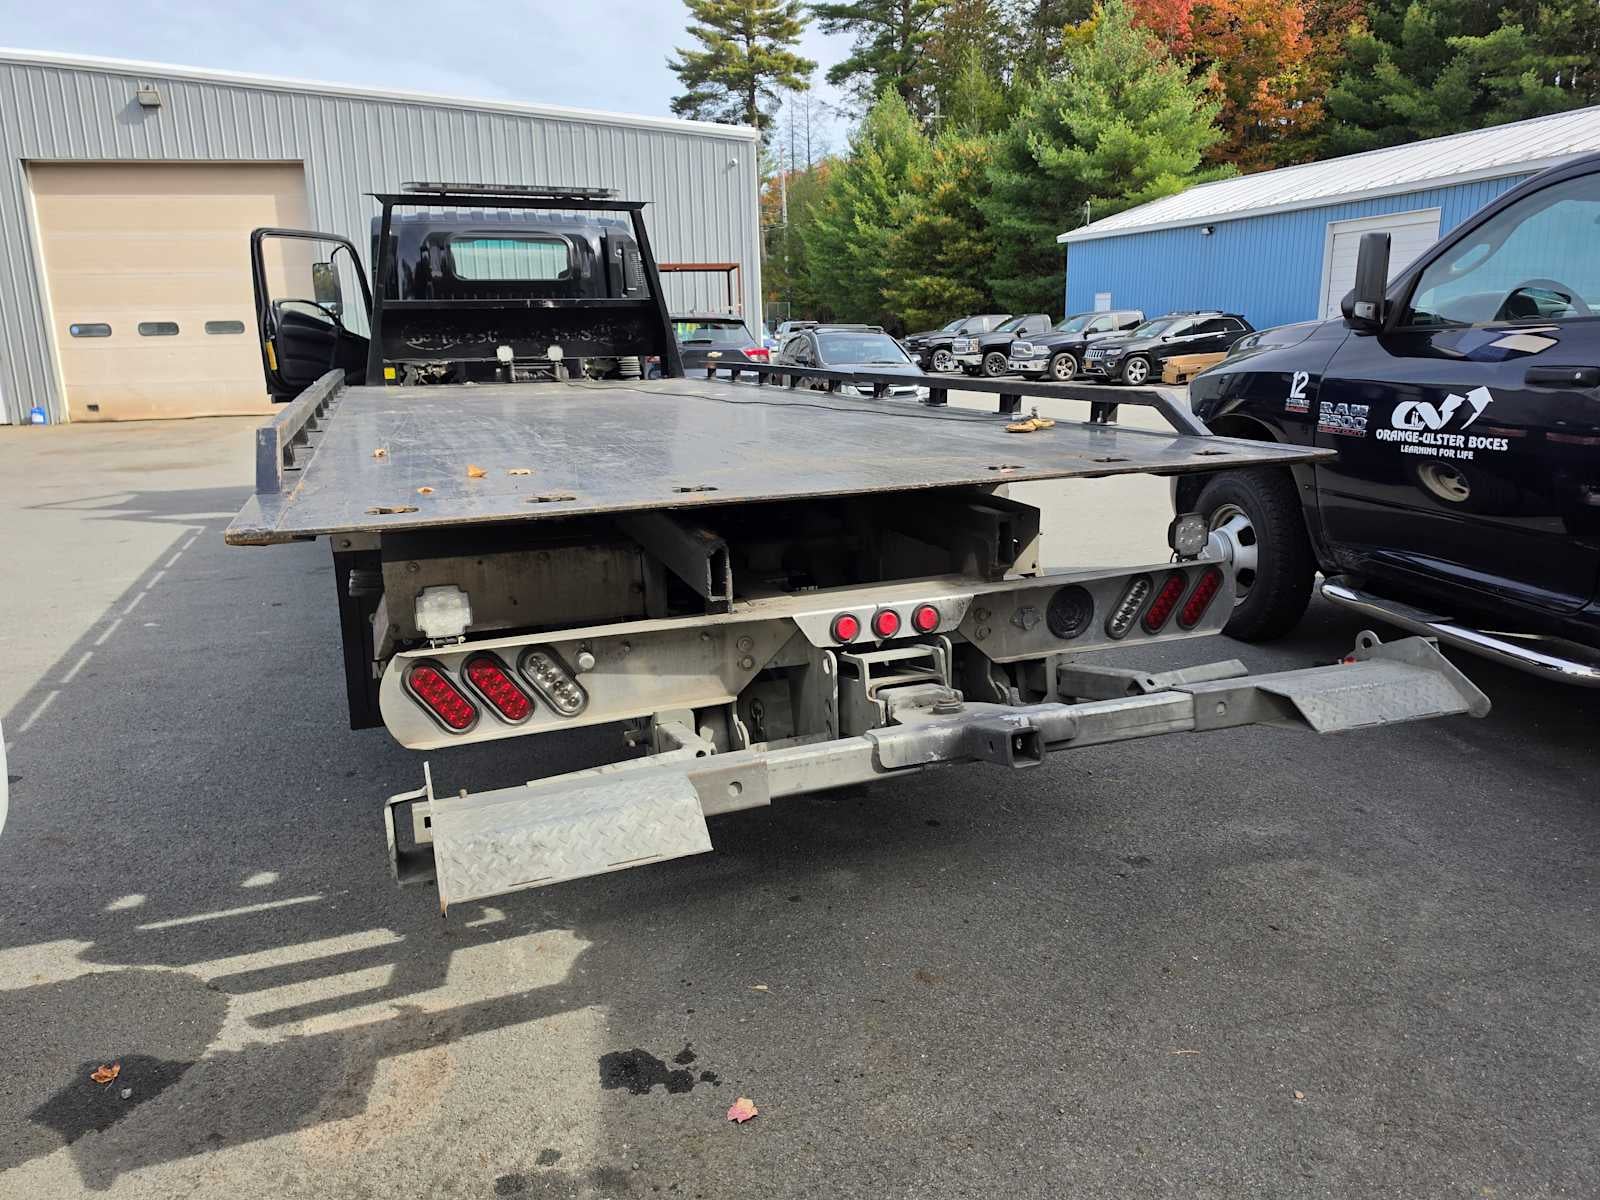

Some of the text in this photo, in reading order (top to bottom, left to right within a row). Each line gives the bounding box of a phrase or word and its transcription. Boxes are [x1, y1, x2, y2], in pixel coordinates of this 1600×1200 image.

[1290, 371, 1309, 399] 12
[1320, 401, 1369, 417] RAM
[1375, 429, 1465, 449] ORANGE-ULSTER
[1467, 437, 1509, 451] BOCES
[1400, 444, 1474, 460] LEARNING FOR LIFE
